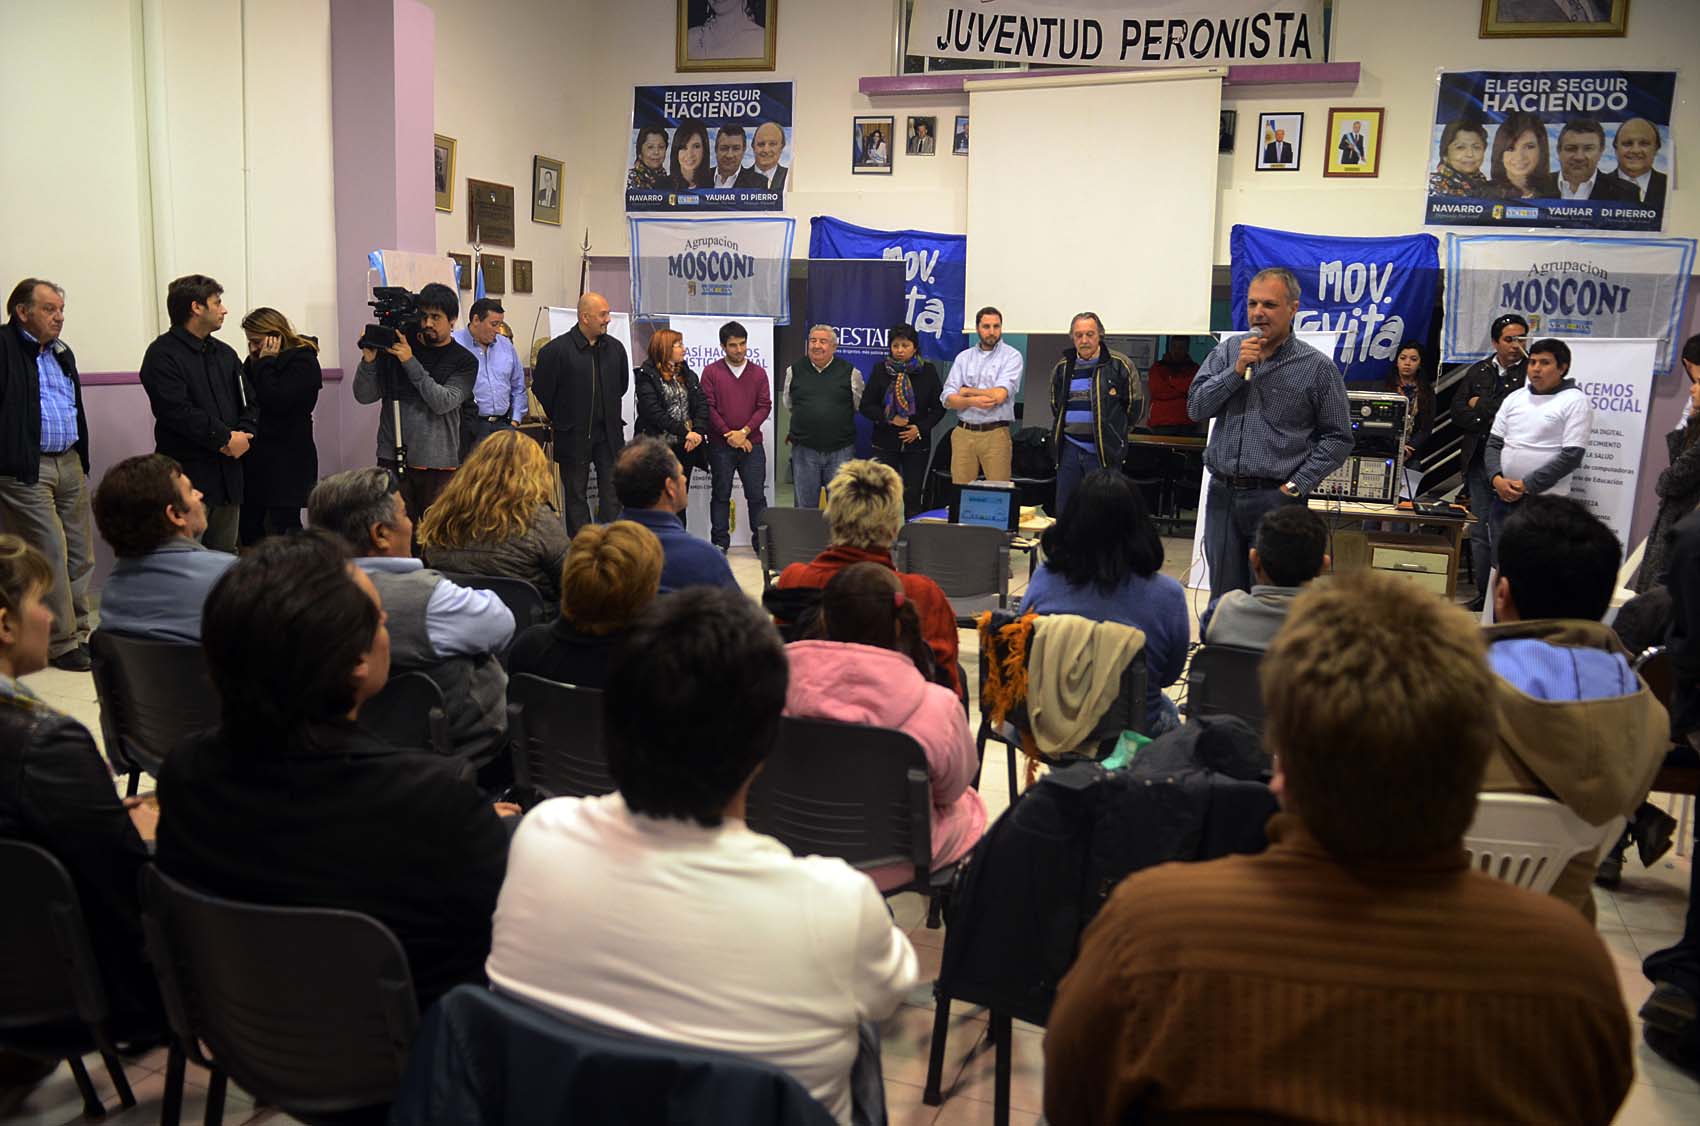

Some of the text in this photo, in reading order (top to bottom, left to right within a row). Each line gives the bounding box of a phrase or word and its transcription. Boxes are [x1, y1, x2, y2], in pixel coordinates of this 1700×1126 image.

[937, 8, 1312, 61] JUVENTUD PERONISTA
[1484, 78, 1628, 93] ELEGIR SEGUIR
[665, 89, 761, 103] ELEGIR SEGUIR
[1482, 92, 1628, 113] HACIENDO
[663, 102, 761, 119] HACIENDO
[629, 194, 663, 202] NAVARRO
[705, 193, 736, 201] YAUHAR
[741, 193, 749, 201] DI
[750, 193, 778, 201] PIERRO
[1432, 204, 1656, 219] NAVARRO YAUHAR DI PIERRO
[684, 235, 739, 251] Agrupacion
[668, 250, 755, 282] MOSCONI
[1528, 260, 1608, 280] Agrupacion
[1500, 277, 1631, 316] MOSCONI
[1578, 382, 1634, 398] ACEMOS
[1591, 397, 1642, 413] SOCIAL
